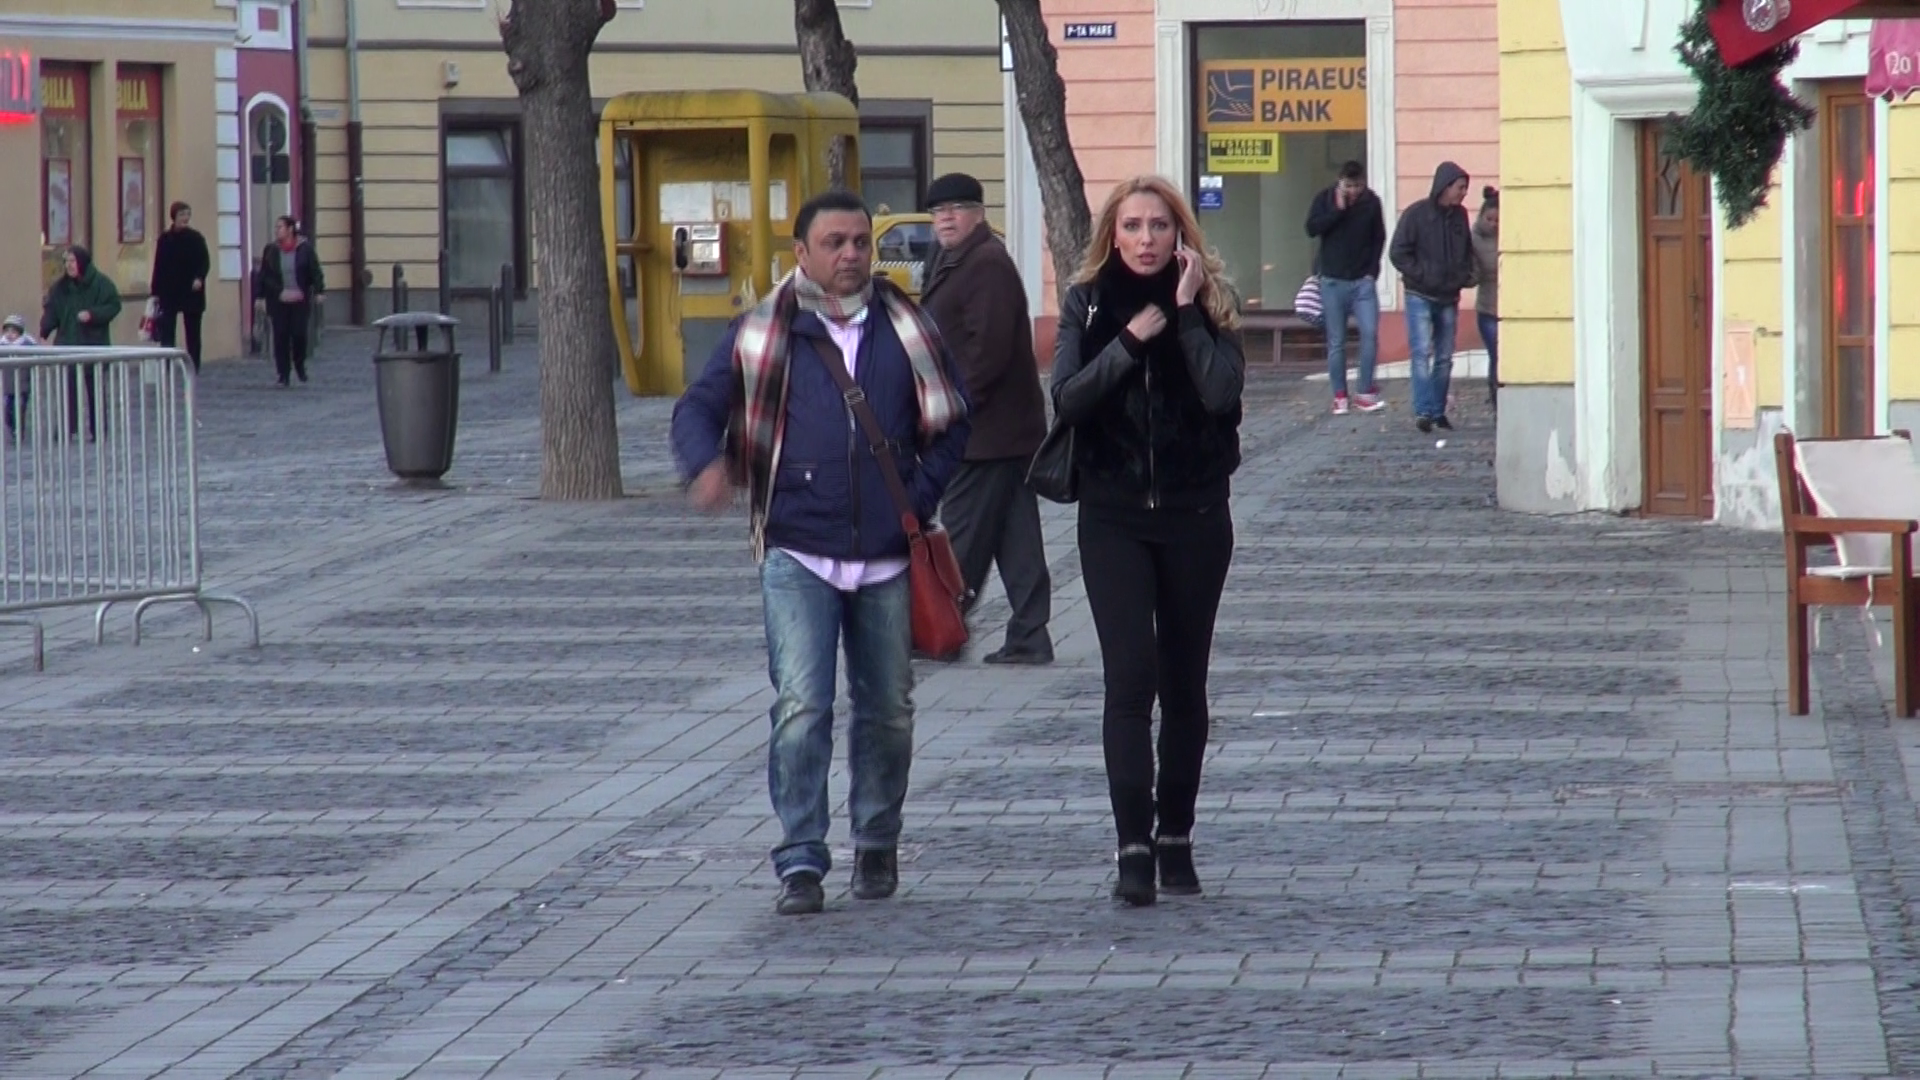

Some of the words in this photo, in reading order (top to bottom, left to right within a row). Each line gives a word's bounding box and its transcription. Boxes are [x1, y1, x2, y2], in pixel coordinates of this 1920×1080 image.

[1089, 24, 1113, 37] MARE
[1261, 67, 1366, 90] PIRAEUS
[1261, 99, 1332, 122] BANK
